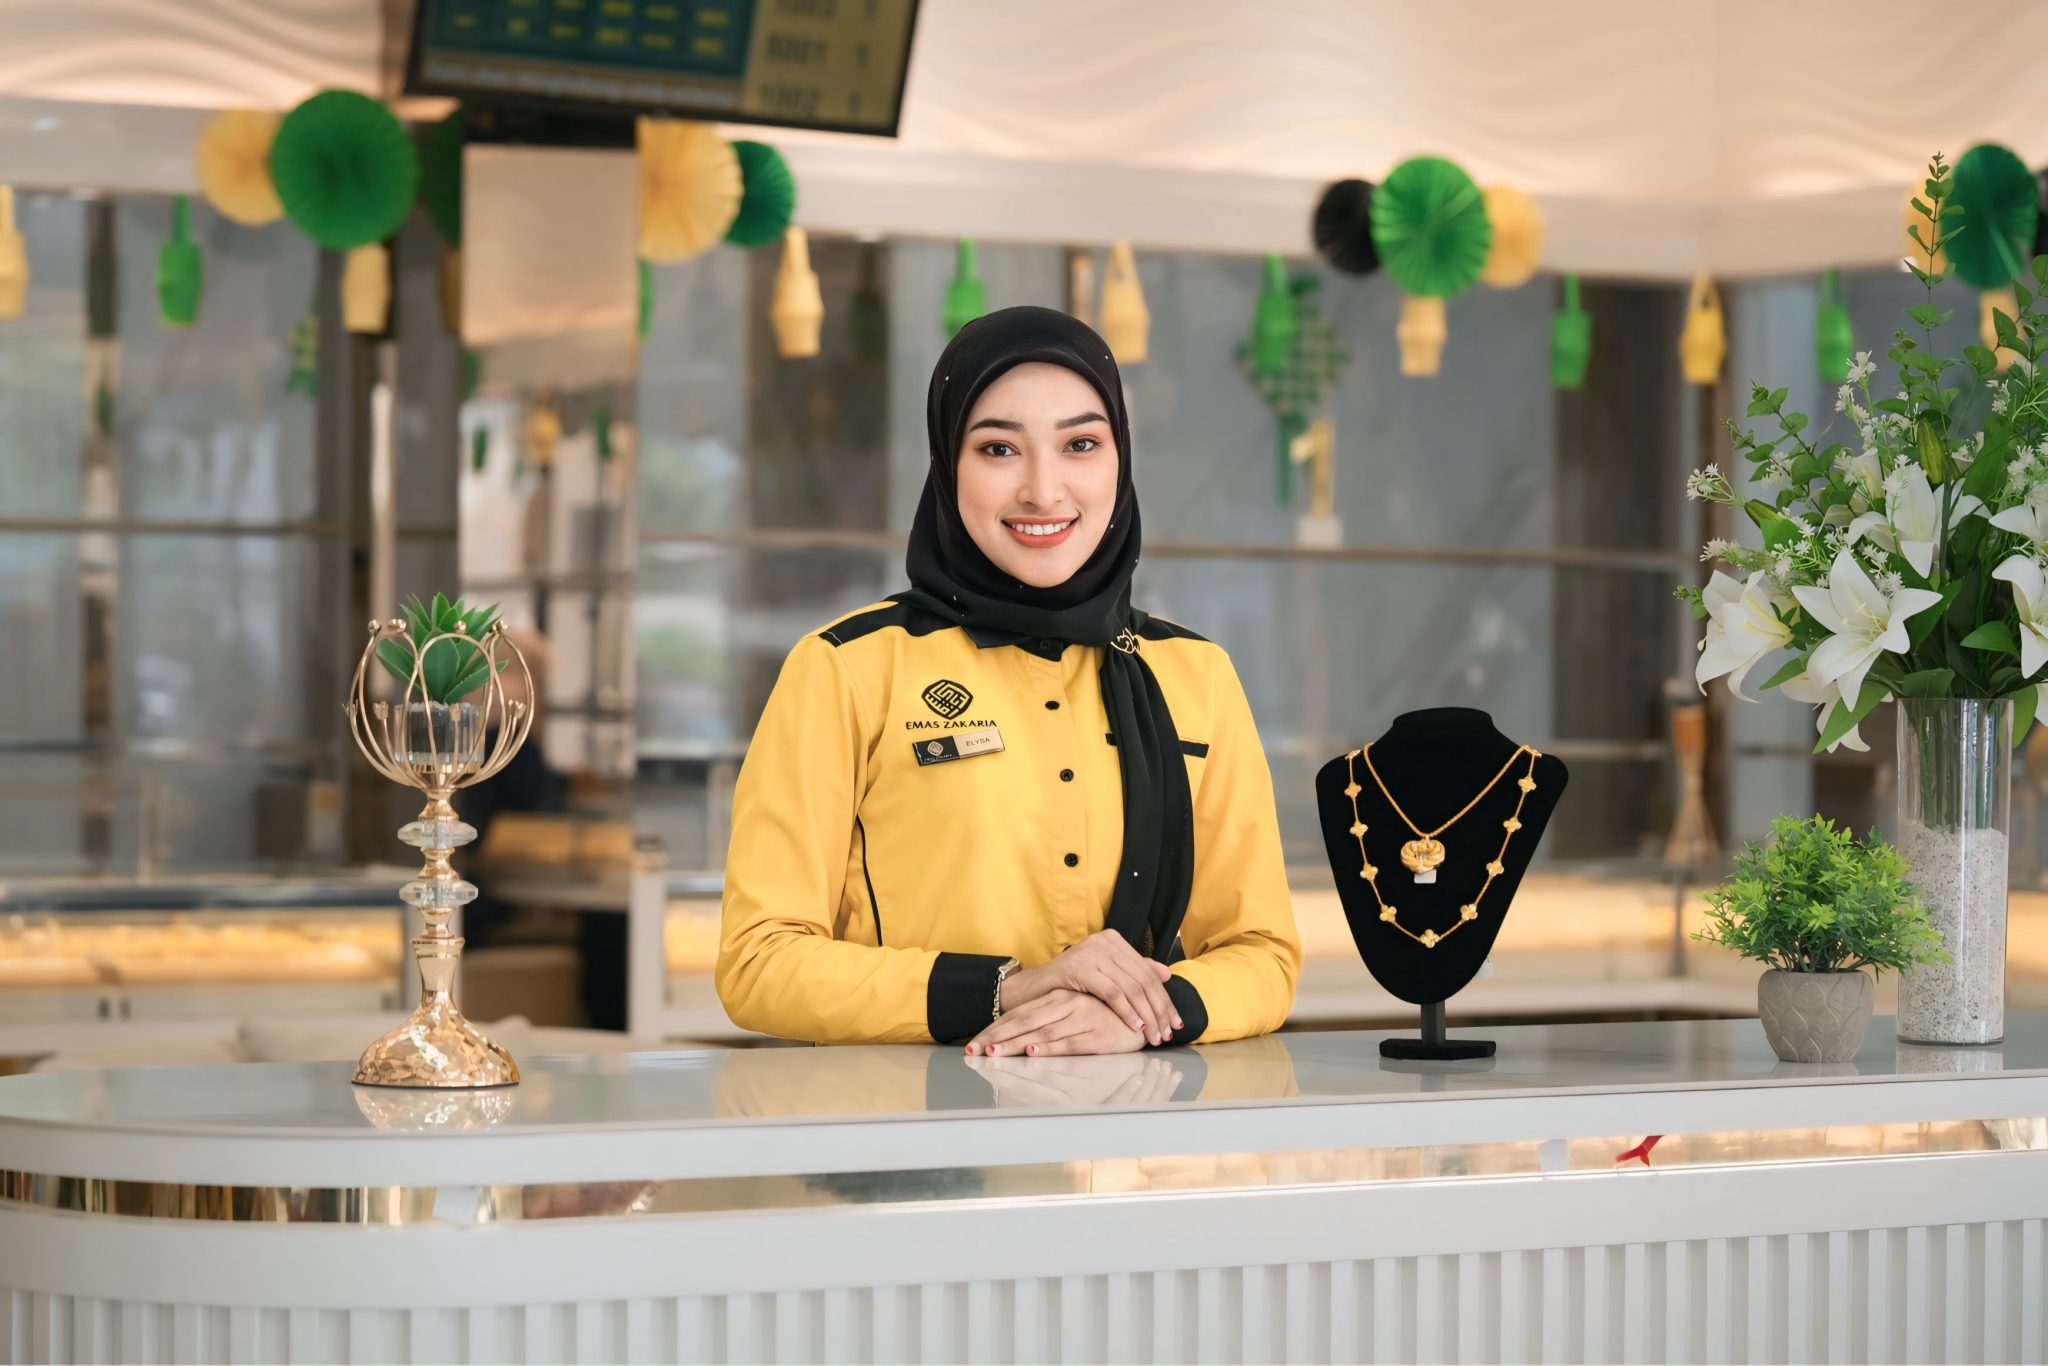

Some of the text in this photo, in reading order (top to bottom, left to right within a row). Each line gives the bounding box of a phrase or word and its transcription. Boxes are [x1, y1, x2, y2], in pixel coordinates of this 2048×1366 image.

[906, 720, 997, 730] EMAS ZAKARIA
[965, 737, 990, 747] ELYSA
